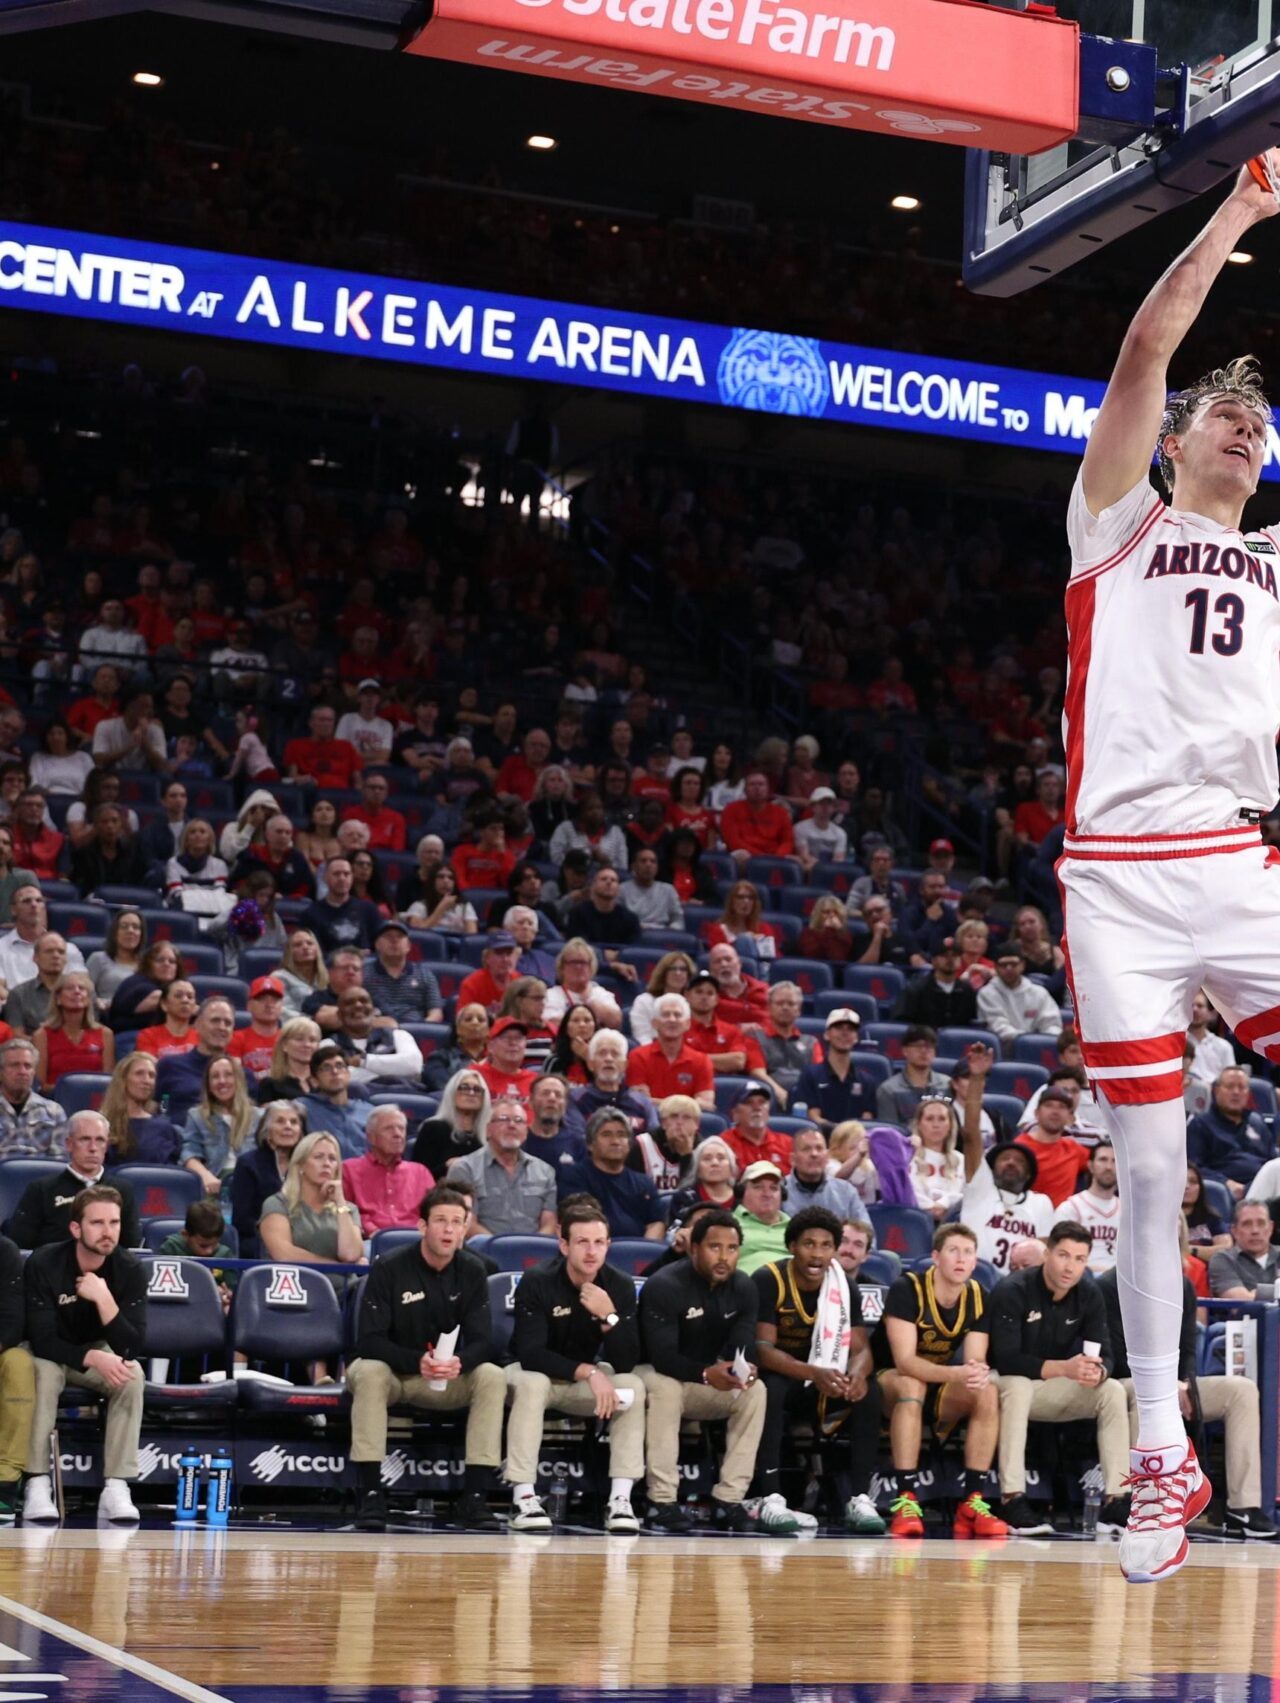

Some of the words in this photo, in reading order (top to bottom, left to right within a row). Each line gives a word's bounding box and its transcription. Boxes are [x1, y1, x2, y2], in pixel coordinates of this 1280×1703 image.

[0, 241, 183, 312] CENTER
[188, 291, 223, 319] AT
[237, 275, 516, 360] ALKEME
[527, 317, 706, 386] ARENA
[829, 362, 998, 428] WELCOME
[1002, 408, 1028, 433] TO
[1144, 542, 1279, 602] ARIZONA
[1185, 588, 1245, 657] 13
